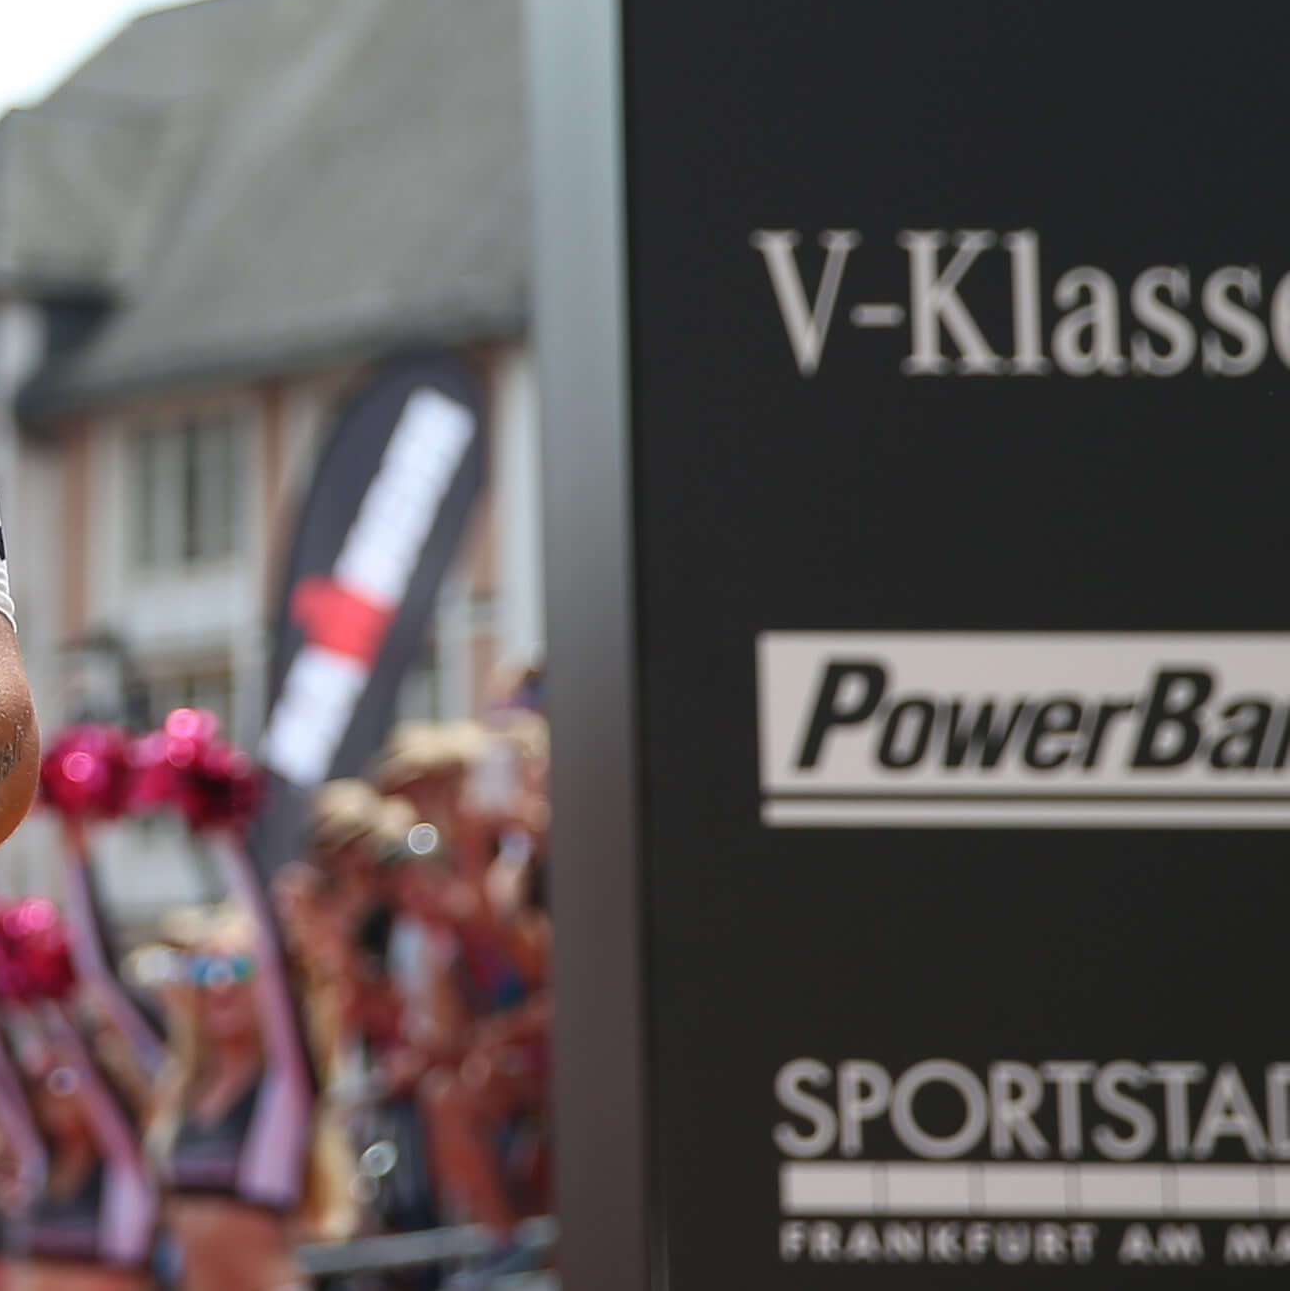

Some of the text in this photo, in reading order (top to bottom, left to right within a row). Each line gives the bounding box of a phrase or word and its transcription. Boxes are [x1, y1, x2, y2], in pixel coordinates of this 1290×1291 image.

[749, 228, 1290, 378] V-Klass
[792, 655, 1290, 773] PowerBa
[778, 1219, 1099, 1265] FRANKFURT
[1119, 1222, 1205, 1265] AM
